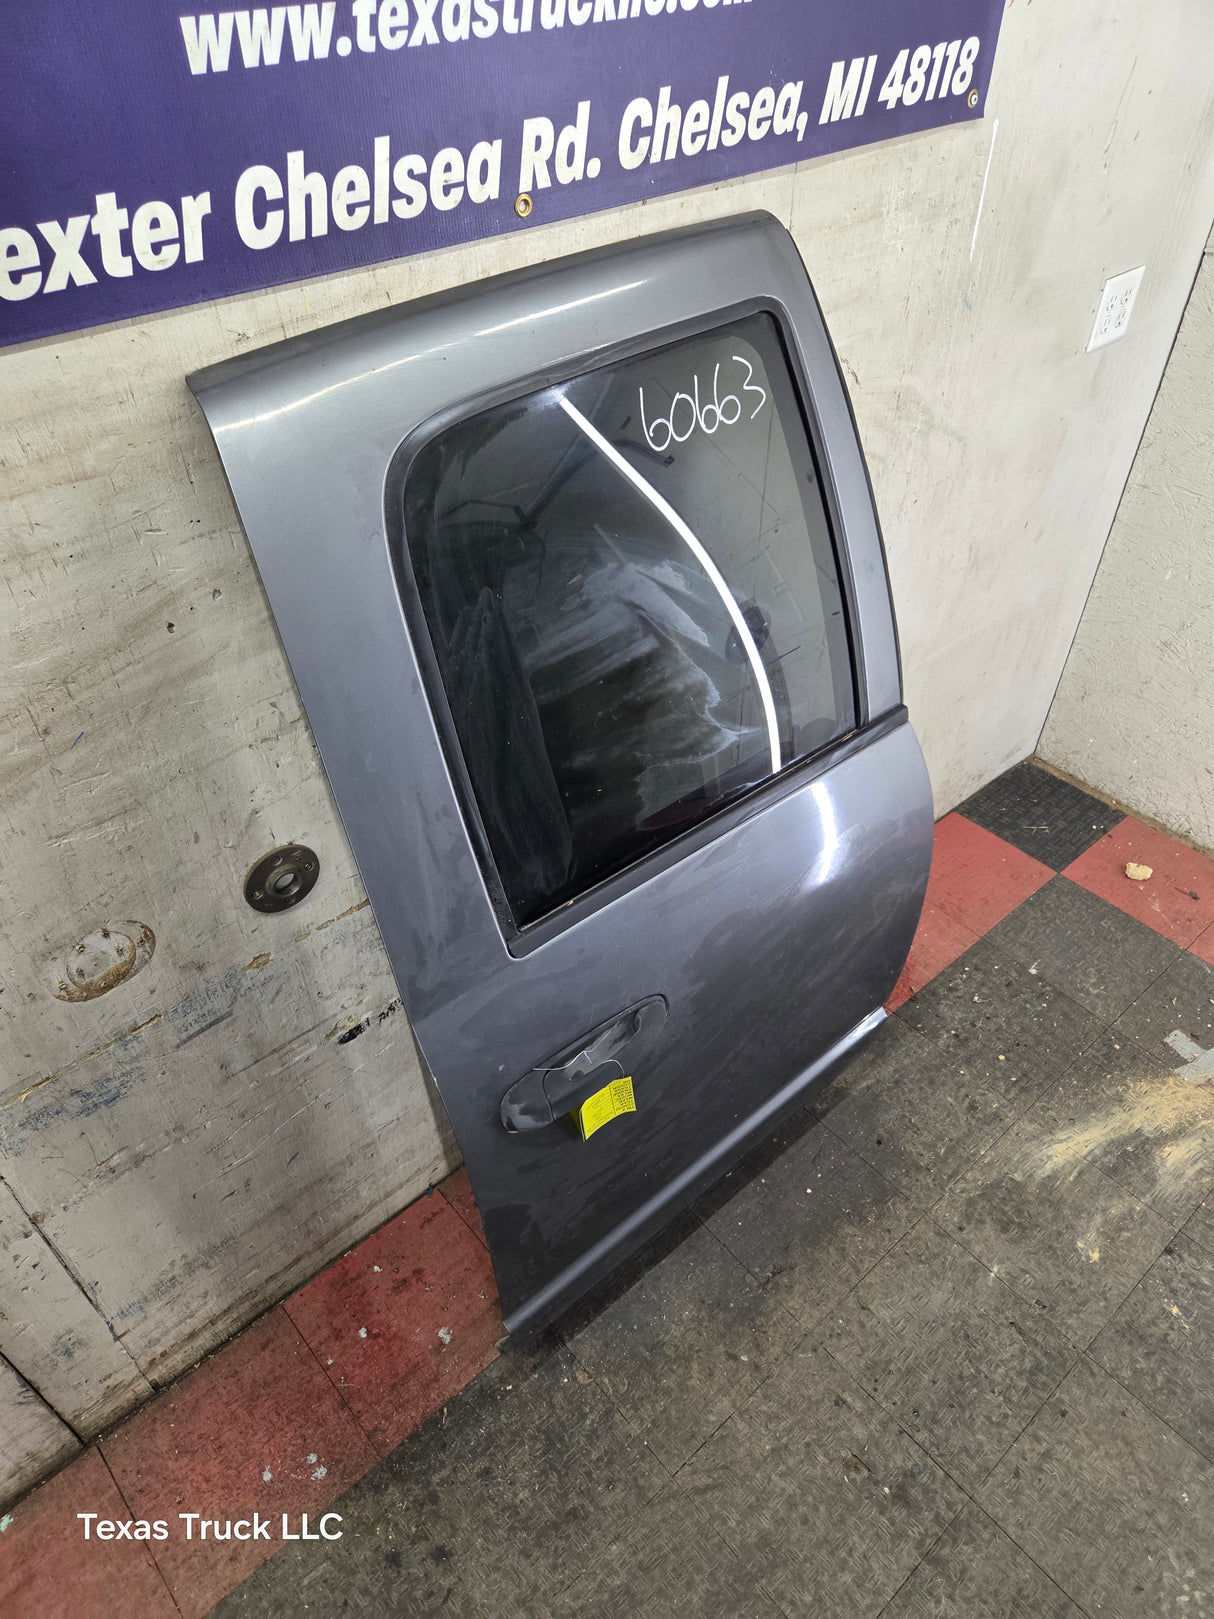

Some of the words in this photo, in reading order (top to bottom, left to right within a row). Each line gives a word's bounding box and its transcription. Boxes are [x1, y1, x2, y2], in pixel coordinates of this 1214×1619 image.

[234, 136, 502, 250] Chelsea
[519, 100, 601, 192] Rd.
[618, 75, 808, 170] Chelsea,
[818, 54, 878, 125] MI
[877, 36, 980, 110] 48118
[639, 355, 766, 451] 60663
